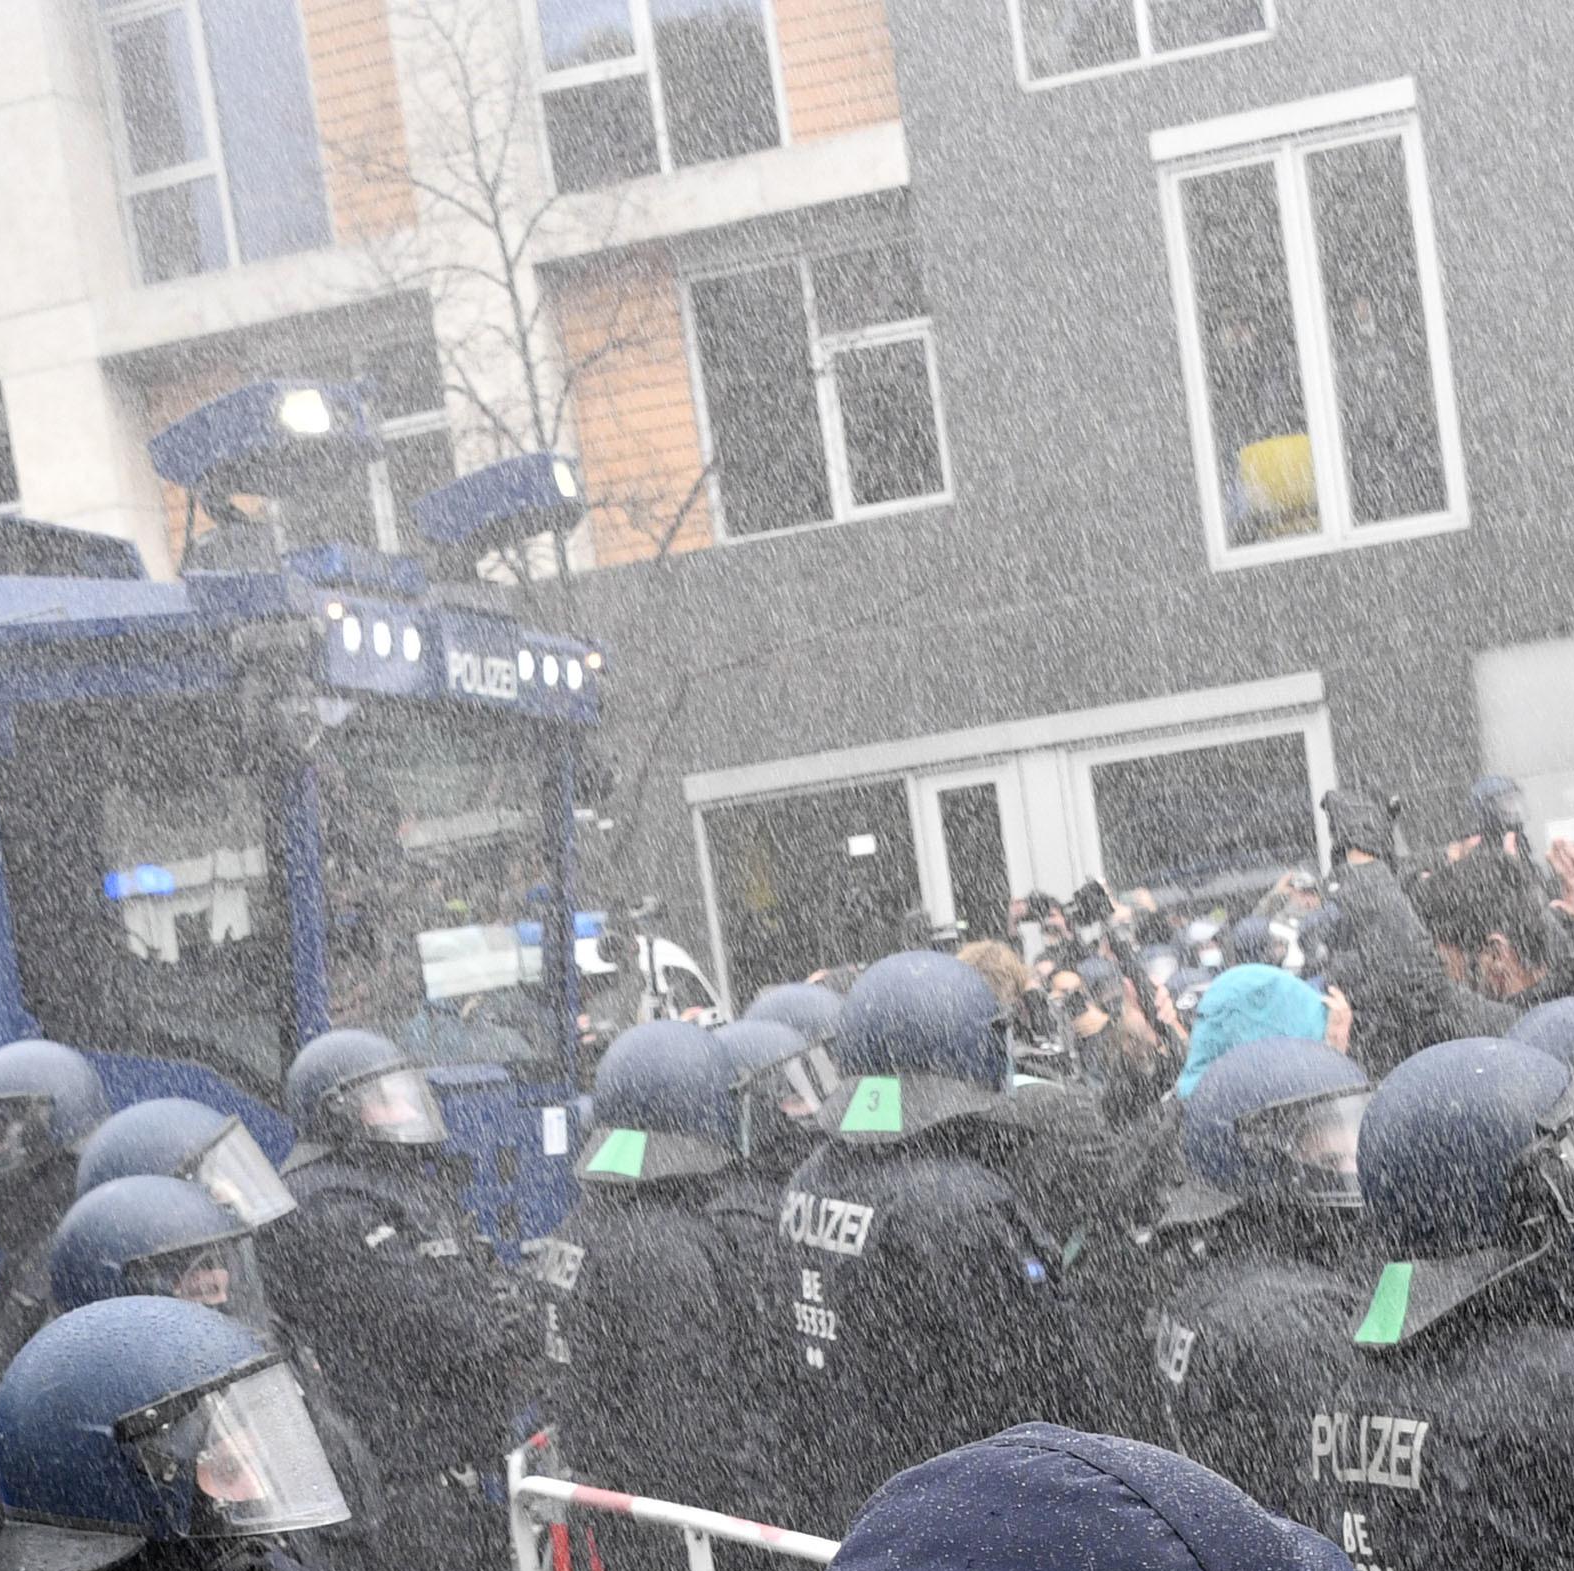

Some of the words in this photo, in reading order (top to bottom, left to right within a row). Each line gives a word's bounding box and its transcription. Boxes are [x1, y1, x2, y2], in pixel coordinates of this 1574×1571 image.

[447, 650, 518, 700] POLIZEI
[778, 1190, 874, 1256] POLIZEI
[802, 1268, 824, 1302] BE
[1342, 1511, 1373, 1555] BE
